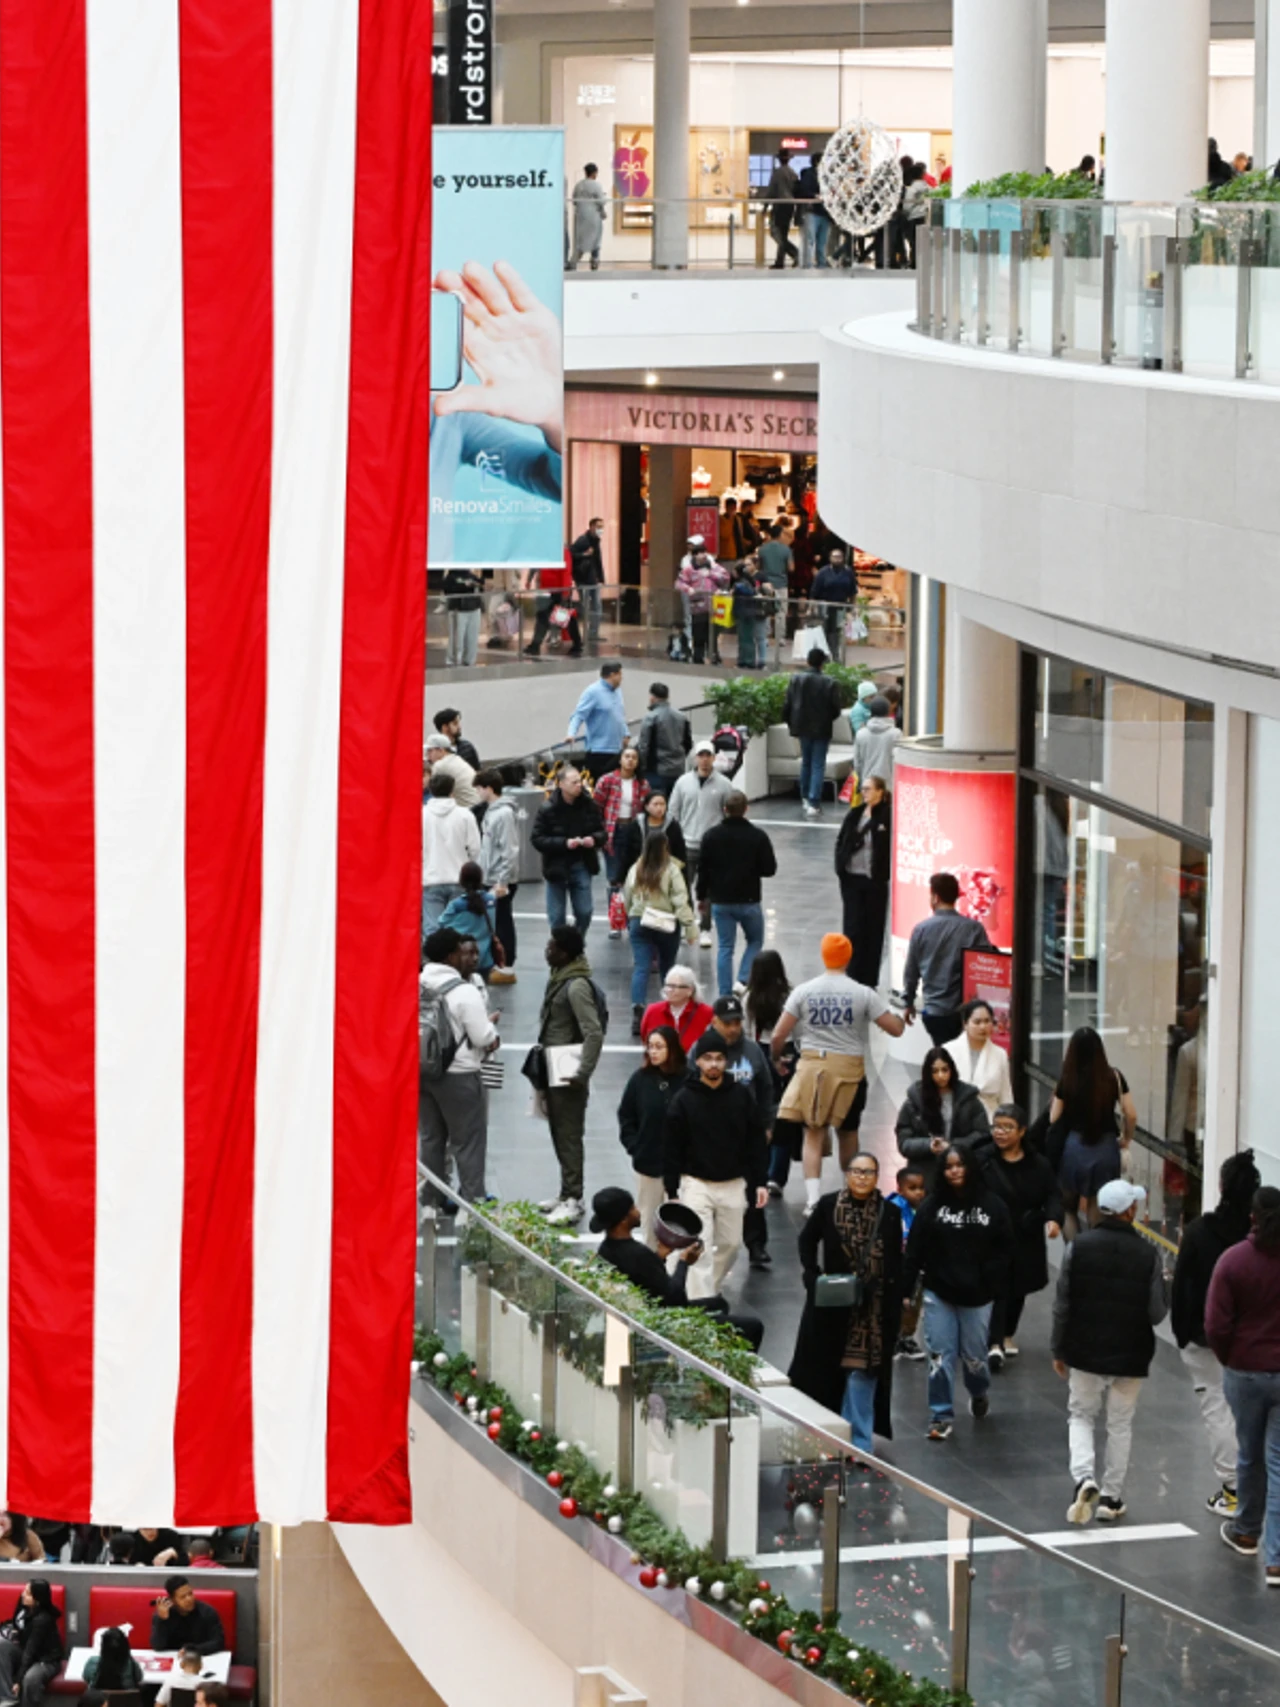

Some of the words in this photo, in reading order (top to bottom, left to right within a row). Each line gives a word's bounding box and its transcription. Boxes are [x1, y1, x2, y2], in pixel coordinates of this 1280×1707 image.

[452, 169, 553, 193] yourself.
[628, 406, 755, 434] VICTORIA'S
[763, 414, 817, 437] SECR
[928, 837, 953, 856] UP
[809, 1007, 854, 1025] 2024
